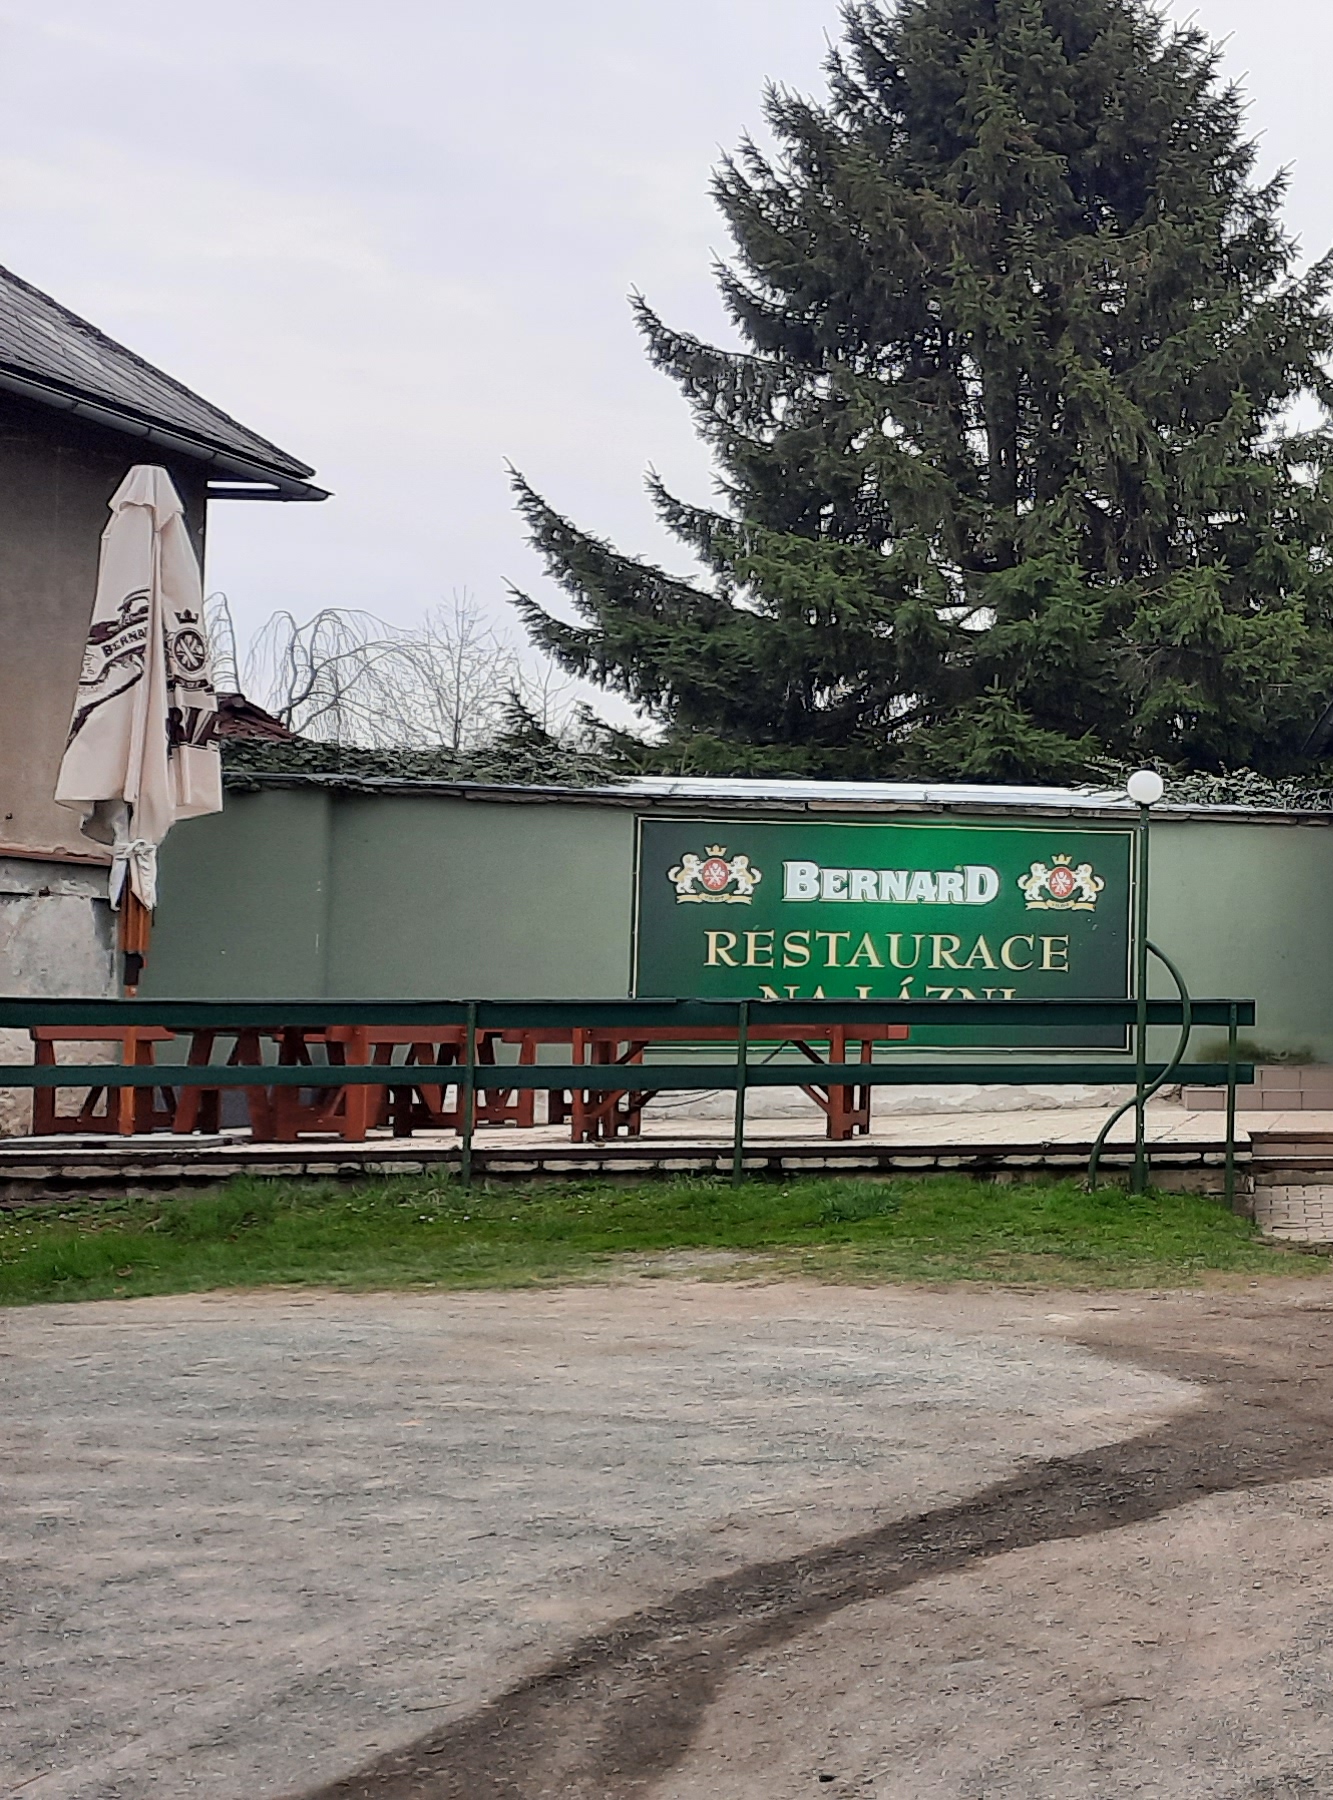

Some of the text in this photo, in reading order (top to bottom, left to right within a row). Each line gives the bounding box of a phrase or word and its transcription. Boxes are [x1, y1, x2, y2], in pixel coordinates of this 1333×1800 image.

[101, 627, 147, 658] BERNA
[783, 861, 999, 904] BERNARD
[703, 929, 1070, 973] RESTAURACE
